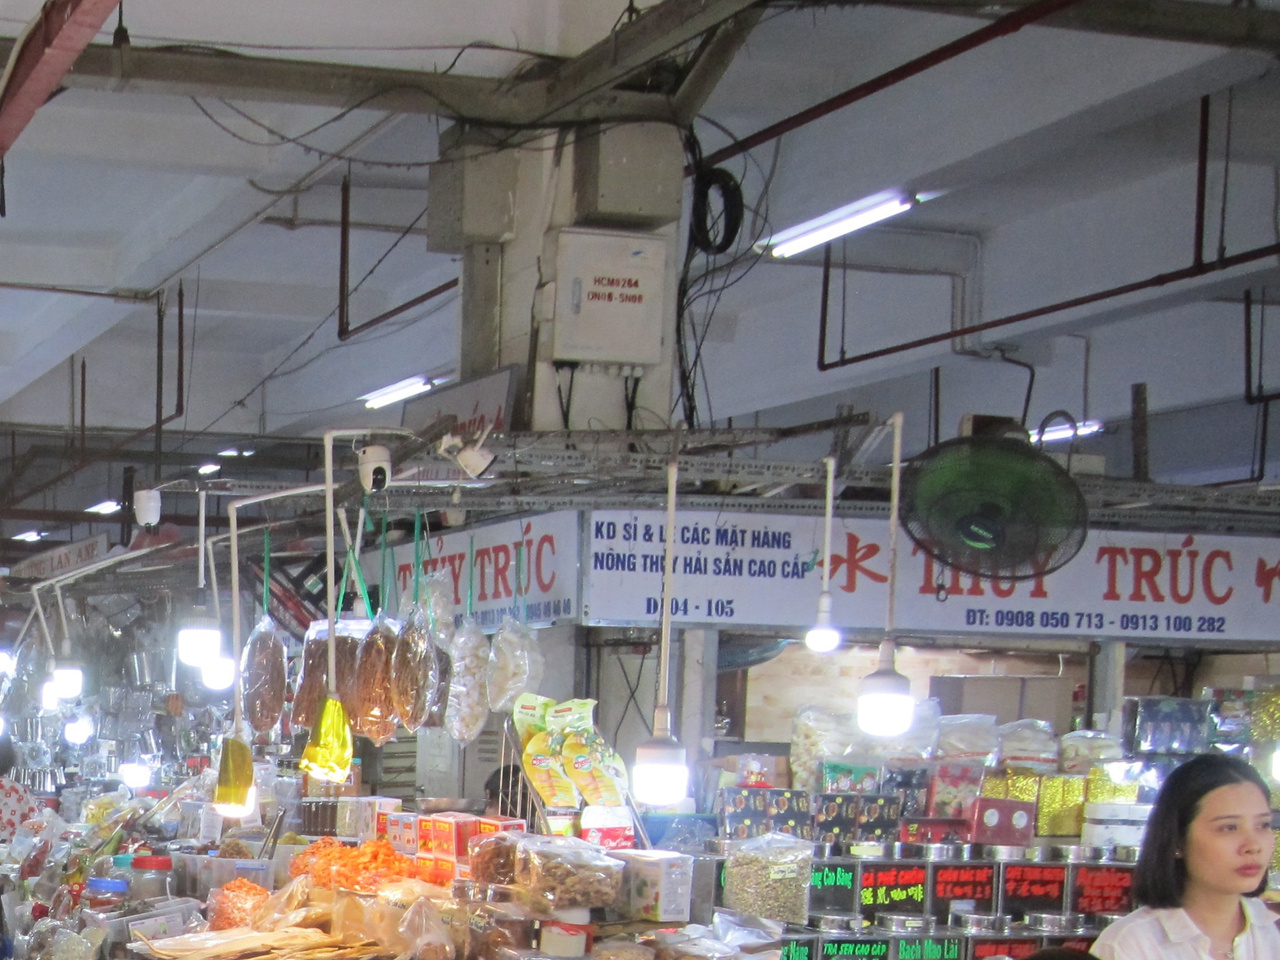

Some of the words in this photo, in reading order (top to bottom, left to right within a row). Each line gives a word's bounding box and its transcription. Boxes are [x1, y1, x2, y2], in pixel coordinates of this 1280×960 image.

[594, 520, 617, 540] KD
[642, 526, 654, 543] &
[659, 524, 676, 543] L
[680, 523, 711, 546] CÁC
[715, 524, 748, 551] MẶT
[751, 526, 792, 550] HÀNG
[473, 522, 556, 602] TRÚC
[593, 548, 637, 572] NÔNG
[683, 551, 708, 575] HẢI
[712, 552, 743, 577] SẢN
[747, 560, 777, 578] CAO
[780, 553, 810, 579] CẤP
[1095, 534, 1234, 606] TRÚC
[645, 597, 689, 617] D04
[705, 598, 736, 618] 105
[965, 608, 990, 627] ĐT:
[995, 610, 1035, 628] 0908
[1039, 611, 1070, 629] 050
[1075, 612, 1105, 630] 713
[1120, 613, 1160, 631] 0913
[1164, 615, 1193, 632] 100
[1196, 616, 1226, 633] 282
